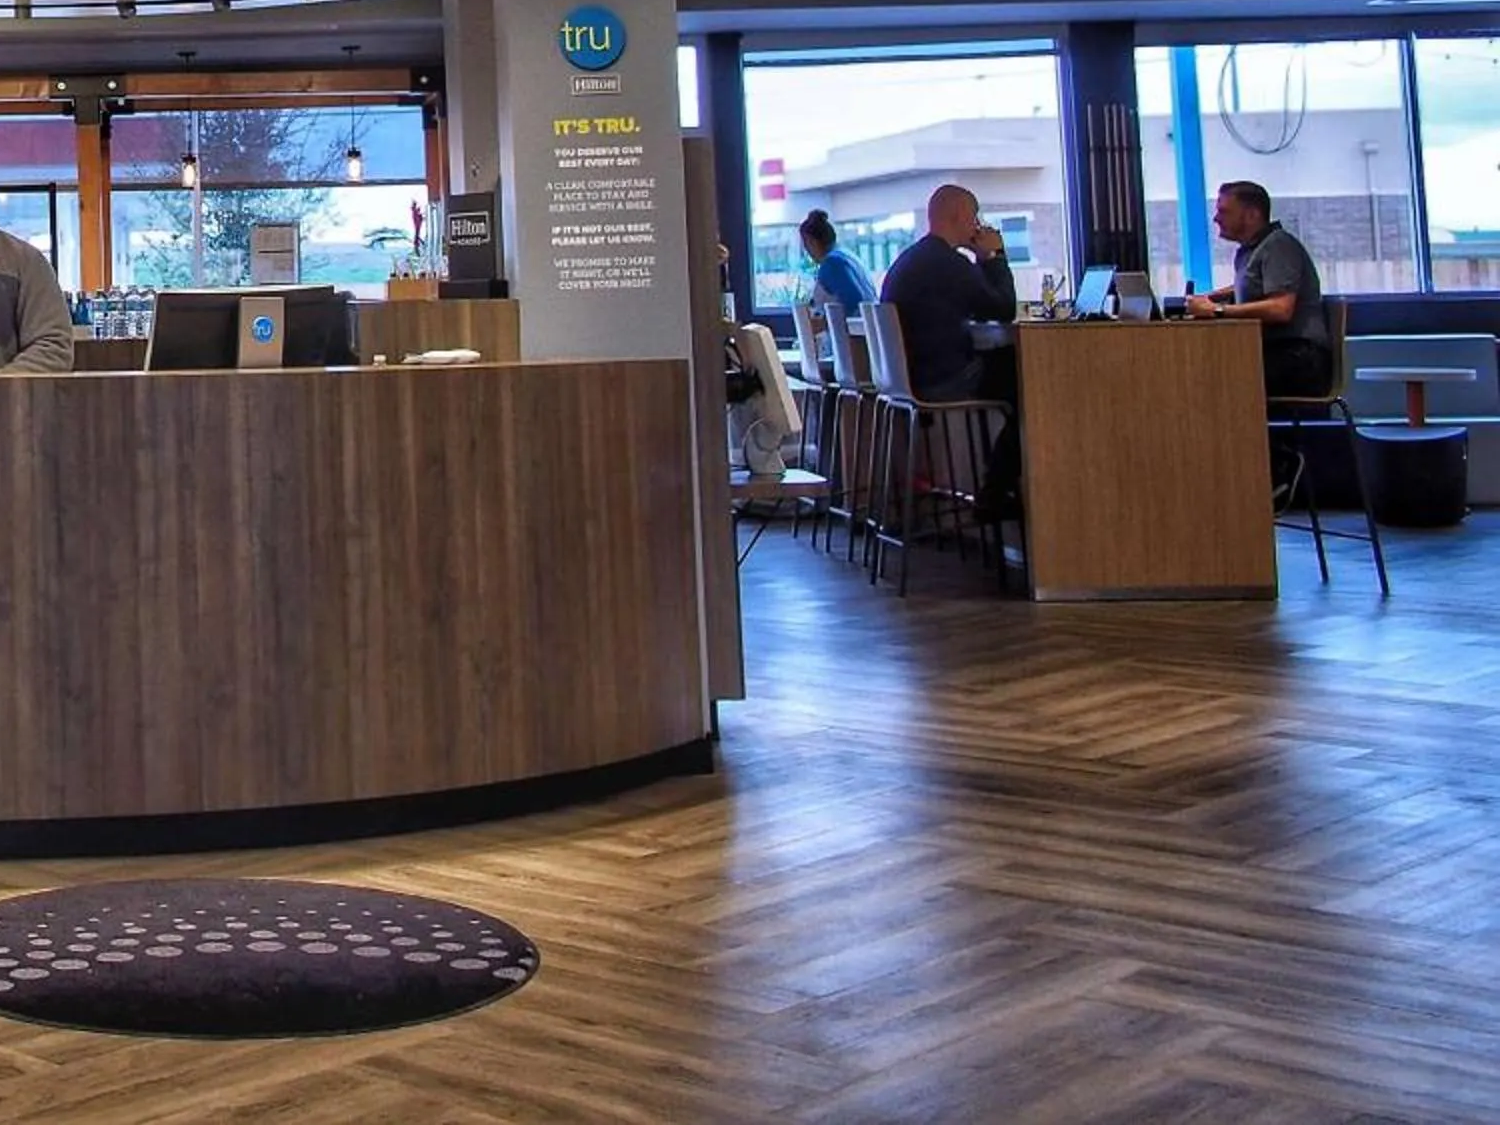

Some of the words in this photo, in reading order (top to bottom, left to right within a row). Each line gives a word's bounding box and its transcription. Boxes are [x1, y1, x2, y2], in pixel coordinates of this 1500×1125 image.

[560, 21, 611, 51] tru
[575, 78, 617, 91] Hilton
[553, 119, 591, 135] IT'S
[594, 117, 641, 133] TRU.
[554, 148, 575, 157] YOU
[577, 147, 620, 156] DESERVE
[621, 146, 643, 155] OUR
[558, 160, 582, 168] BEST
[584, 159, 614, 167] EVERY
[451, 218, 486, 236] Hilton
[582, 225, 602, 233] NOT
[604, 224, 626, 233] OUR
[552, 236, 587, 245] PLEASE
[589, 236, 605, 244] LET
[607, 235, 621, 243] US
